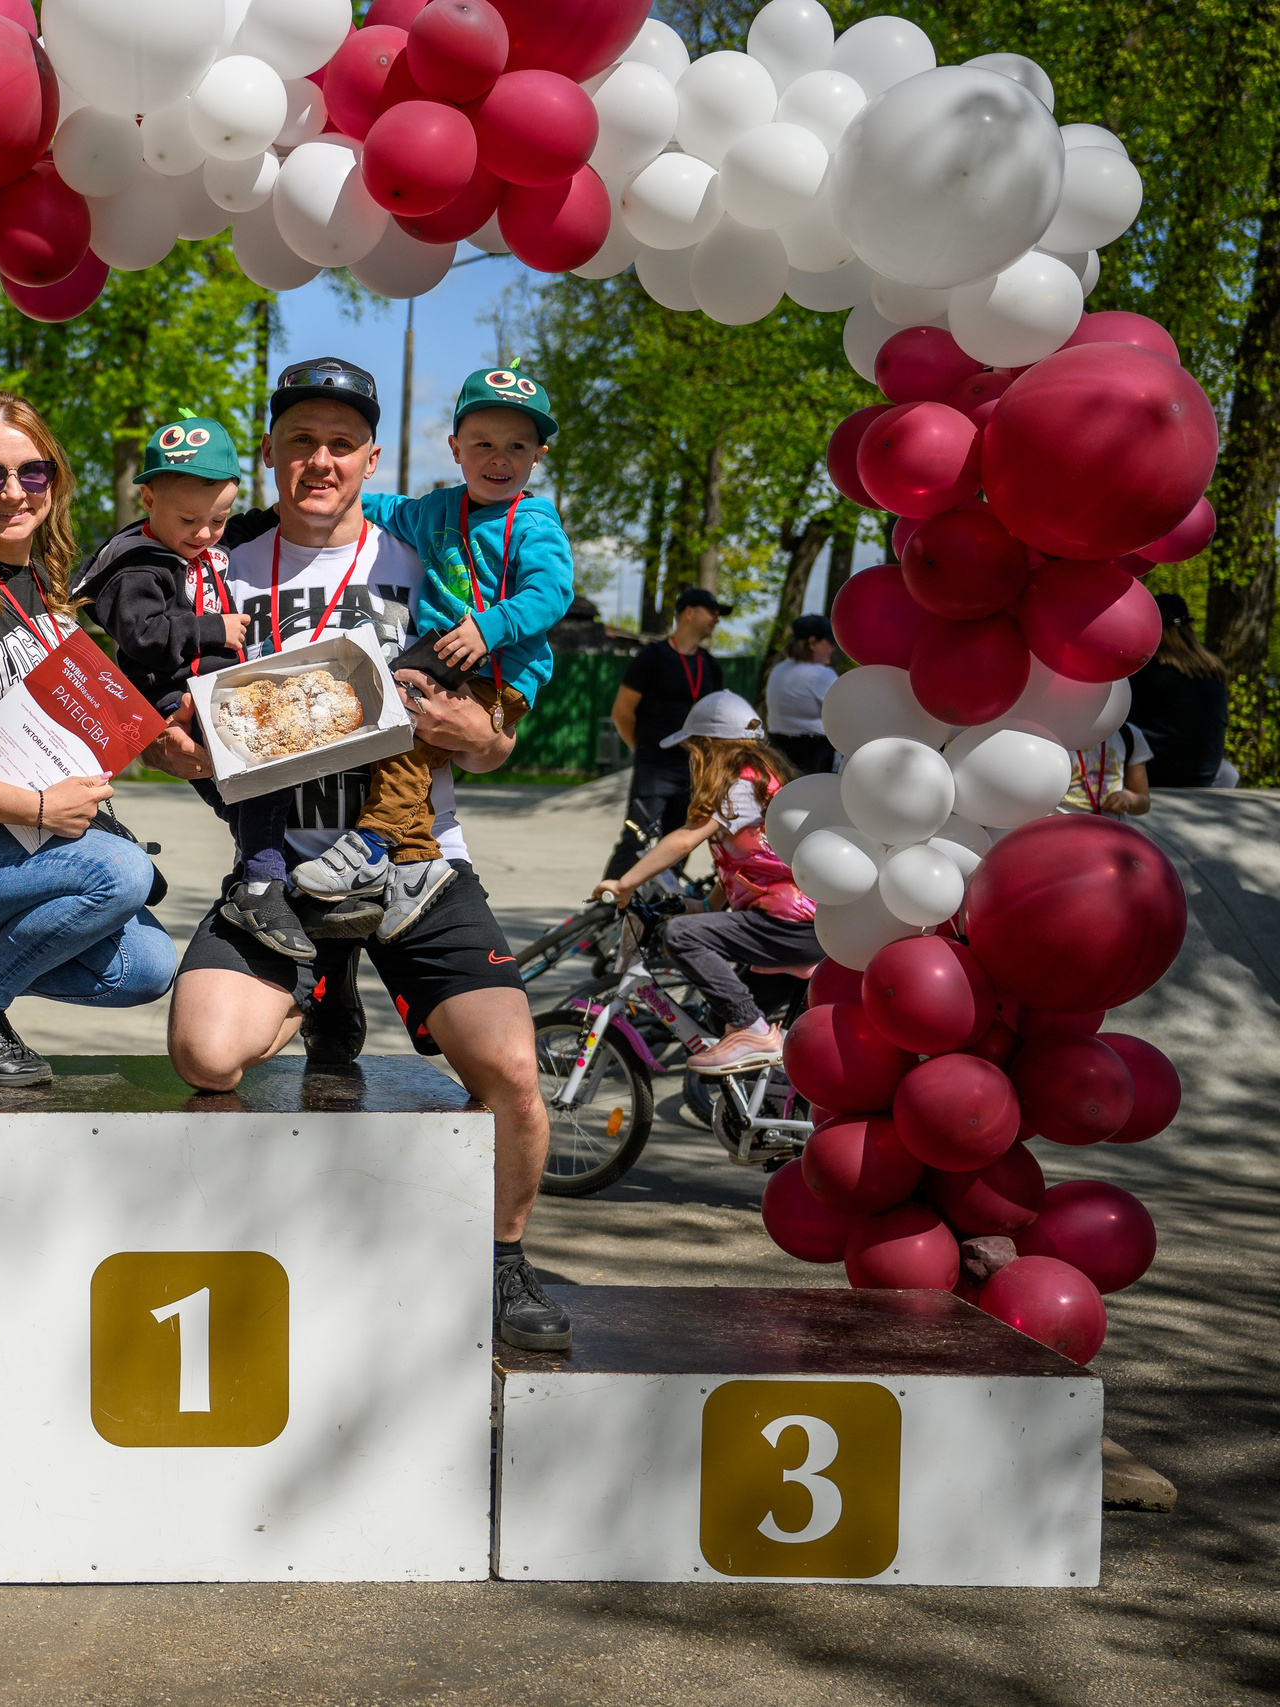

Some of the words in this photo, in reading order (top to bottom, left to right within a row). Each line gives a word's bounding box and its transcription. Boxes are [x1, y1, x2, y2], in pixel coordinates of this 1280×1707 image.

[22, 723, 53, 757] VIKTORIJAS
[51, 755, 71, 777] PĒRLES
[51, 685, 110, 750] PATEICĪBA
[150, 1286, 211, 1412] 1
[757, 1414, 843, 1544] 3
